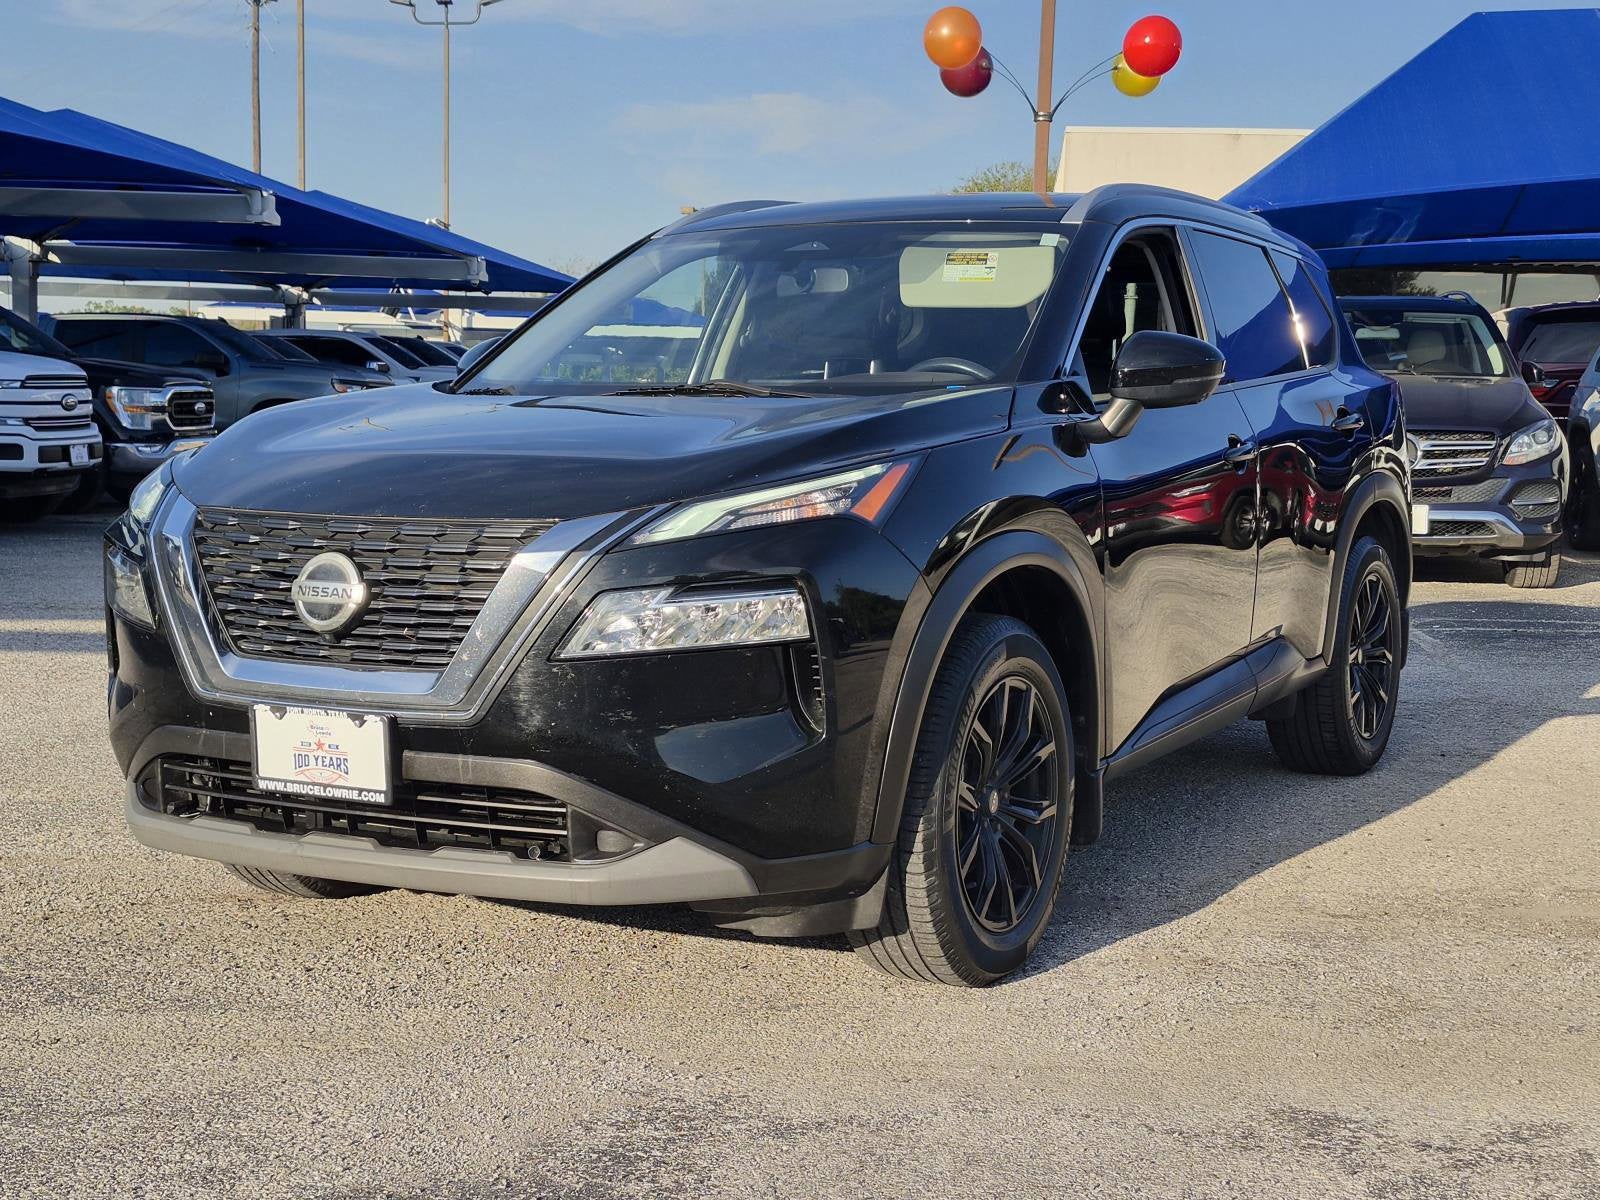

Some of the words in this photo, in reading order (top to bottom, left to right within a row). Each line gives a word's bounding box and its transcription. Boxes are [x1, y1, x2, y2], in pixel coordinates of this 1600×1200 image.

[297, 585, 353, 599] NISSAN
[293, 753, 310, 770] 100
[313, 754, 349, 775] YEARS
[258, 779, 385, 803] WWW.BRUCELOWRIE.COM
